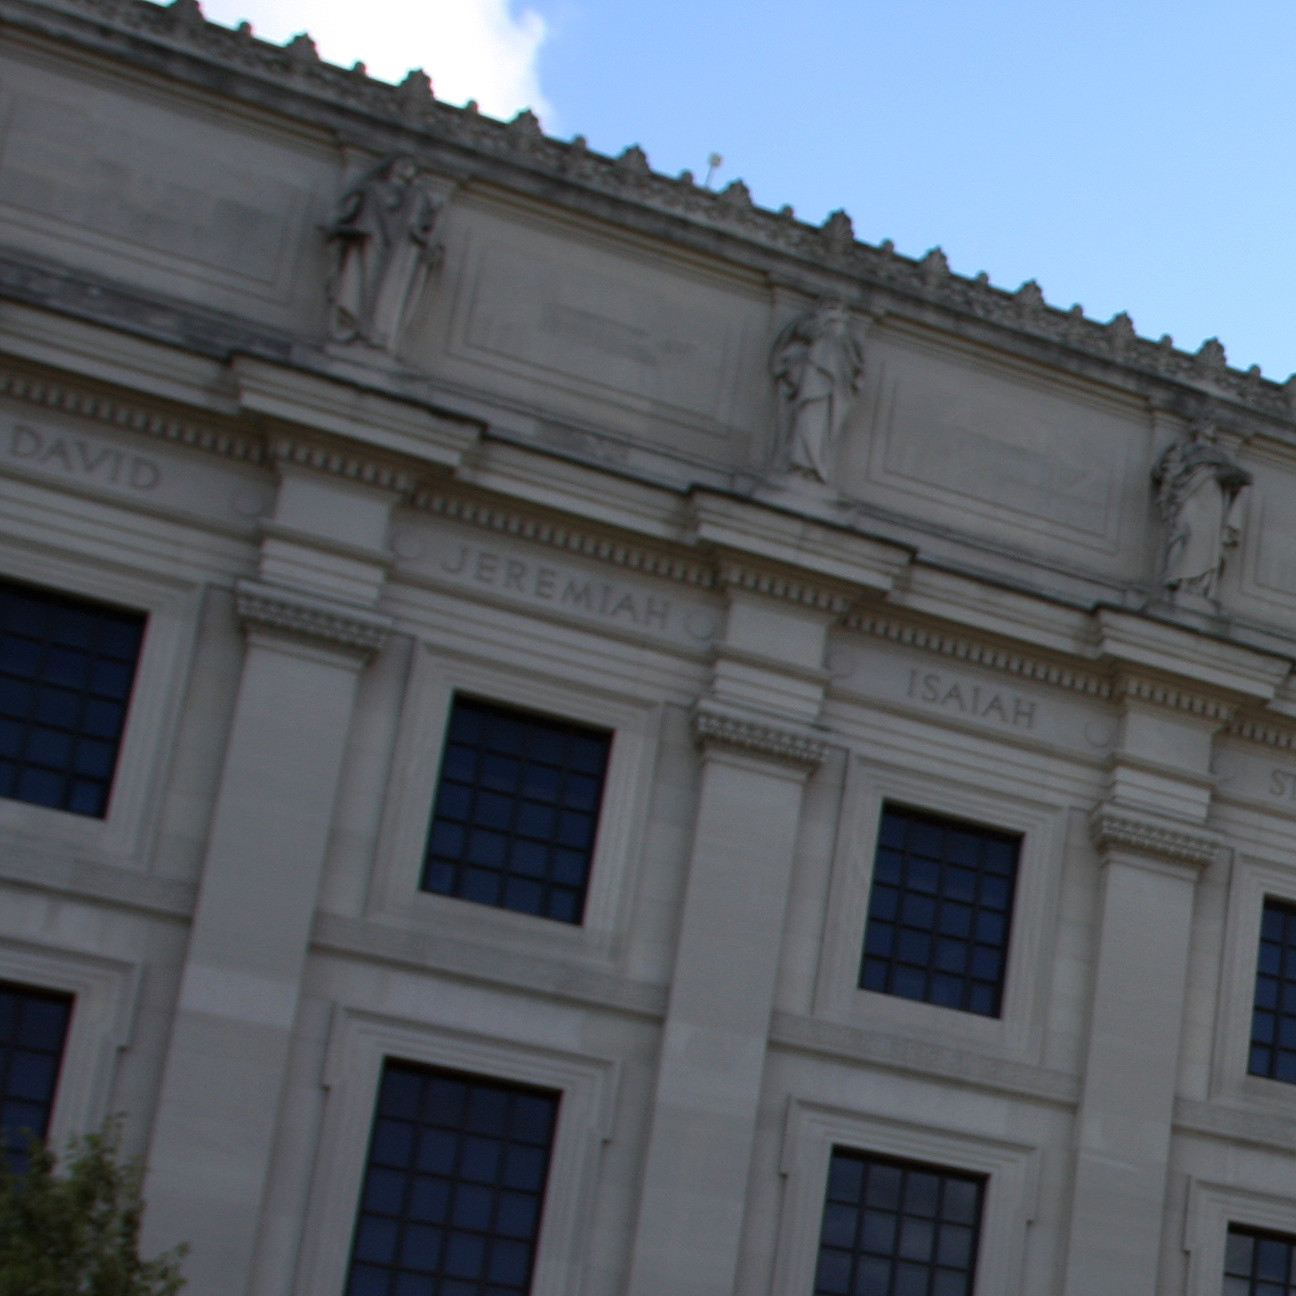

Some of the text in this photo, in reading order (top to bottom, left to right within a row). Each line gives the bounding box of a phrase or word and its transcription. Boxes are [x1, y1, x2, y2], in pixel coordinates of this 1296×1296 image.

[9, 423, 163, 491] DAVID
[439, 544, 672, 631] JEREMIAH
[906, 668, 1038, 730] ISAIAH
